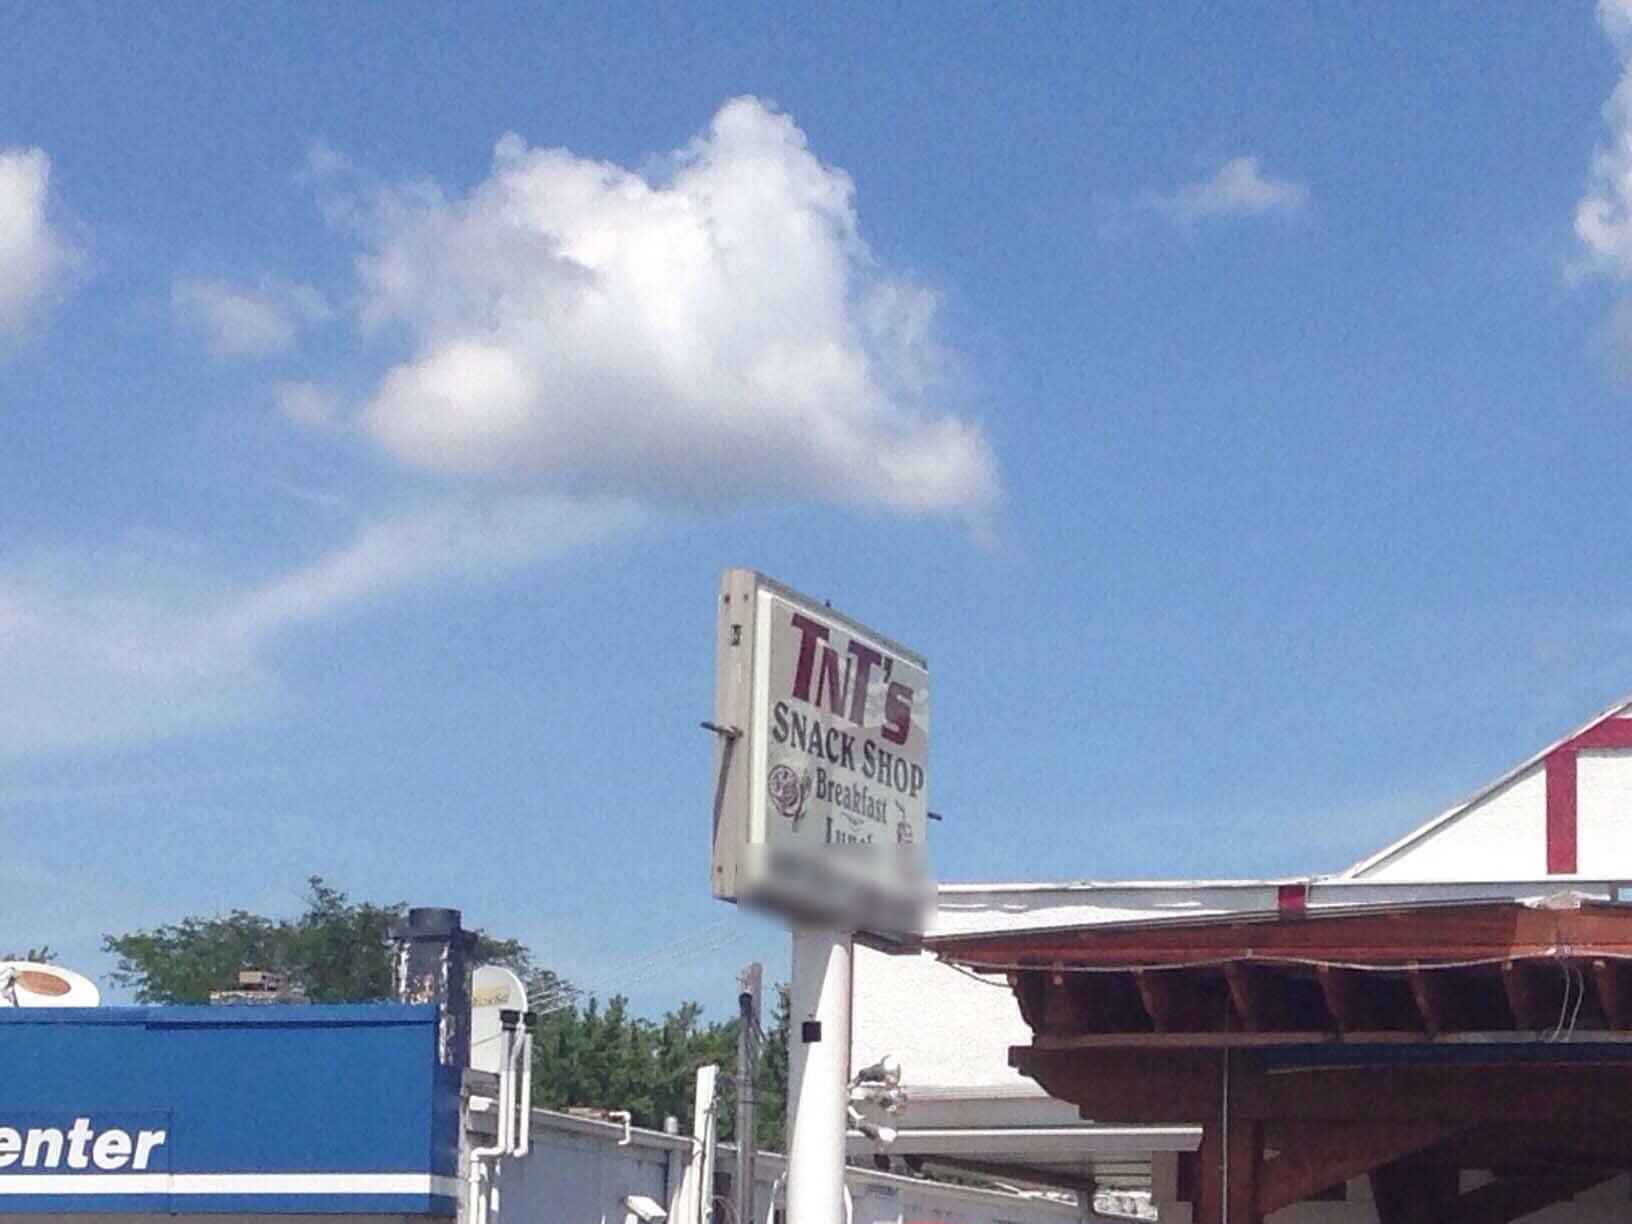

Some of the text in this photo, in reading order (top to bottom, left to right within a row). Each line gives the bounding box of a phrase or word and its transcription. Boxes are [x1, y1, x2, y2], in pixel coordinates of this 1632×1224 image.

[772, 701, 924, 798] SNACK SHOP
[815, 767, 888, 825] Breakfast
[0, 1117, 167, 1170] enter
